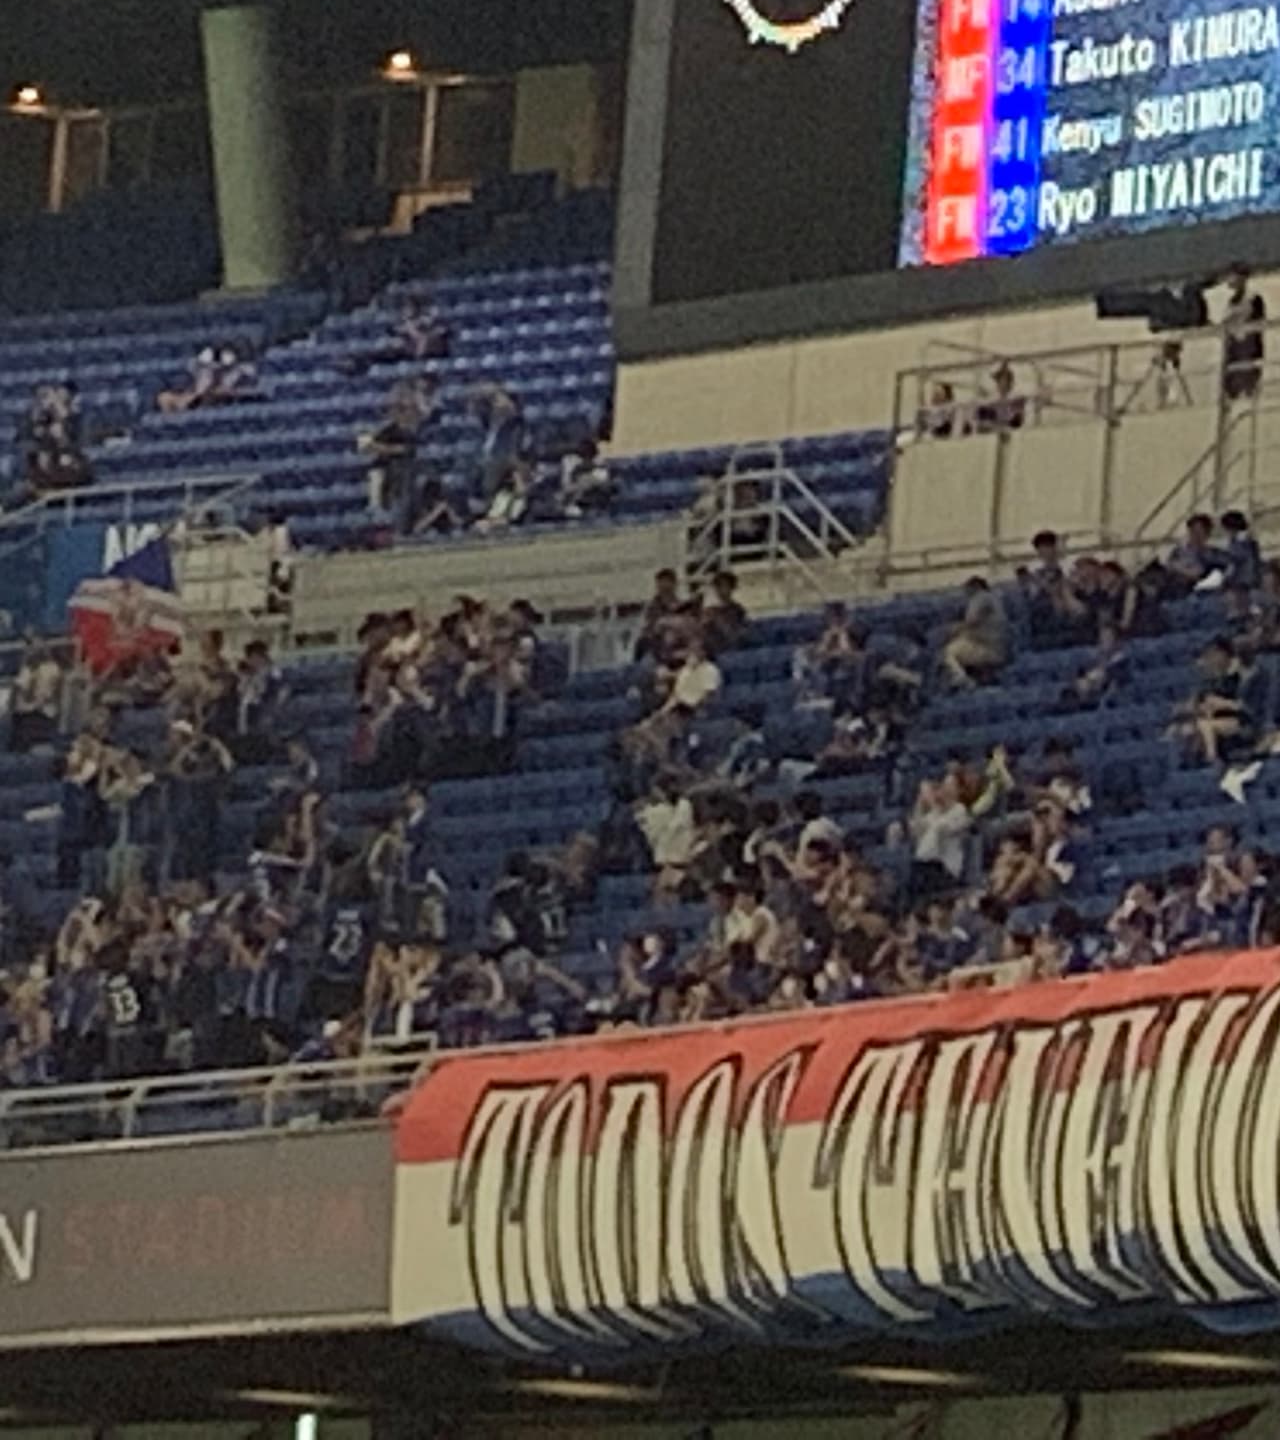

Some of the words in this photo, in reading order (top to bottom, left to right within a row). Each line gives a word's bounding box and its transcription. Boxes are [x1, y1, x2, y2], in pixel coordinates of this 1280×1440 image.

[996, 48, 1035, 95] 34
[1049, 33, 1156, 87] Takuto
[1168, 7, 1280, 68] KIMURA
[991, 118, 1028, 161] 41
[988, 185, 1026, 236] 23
[1038, 182, 1096, 233] Ryo
[1110, 148, 1264, 218] MIYAICHI
